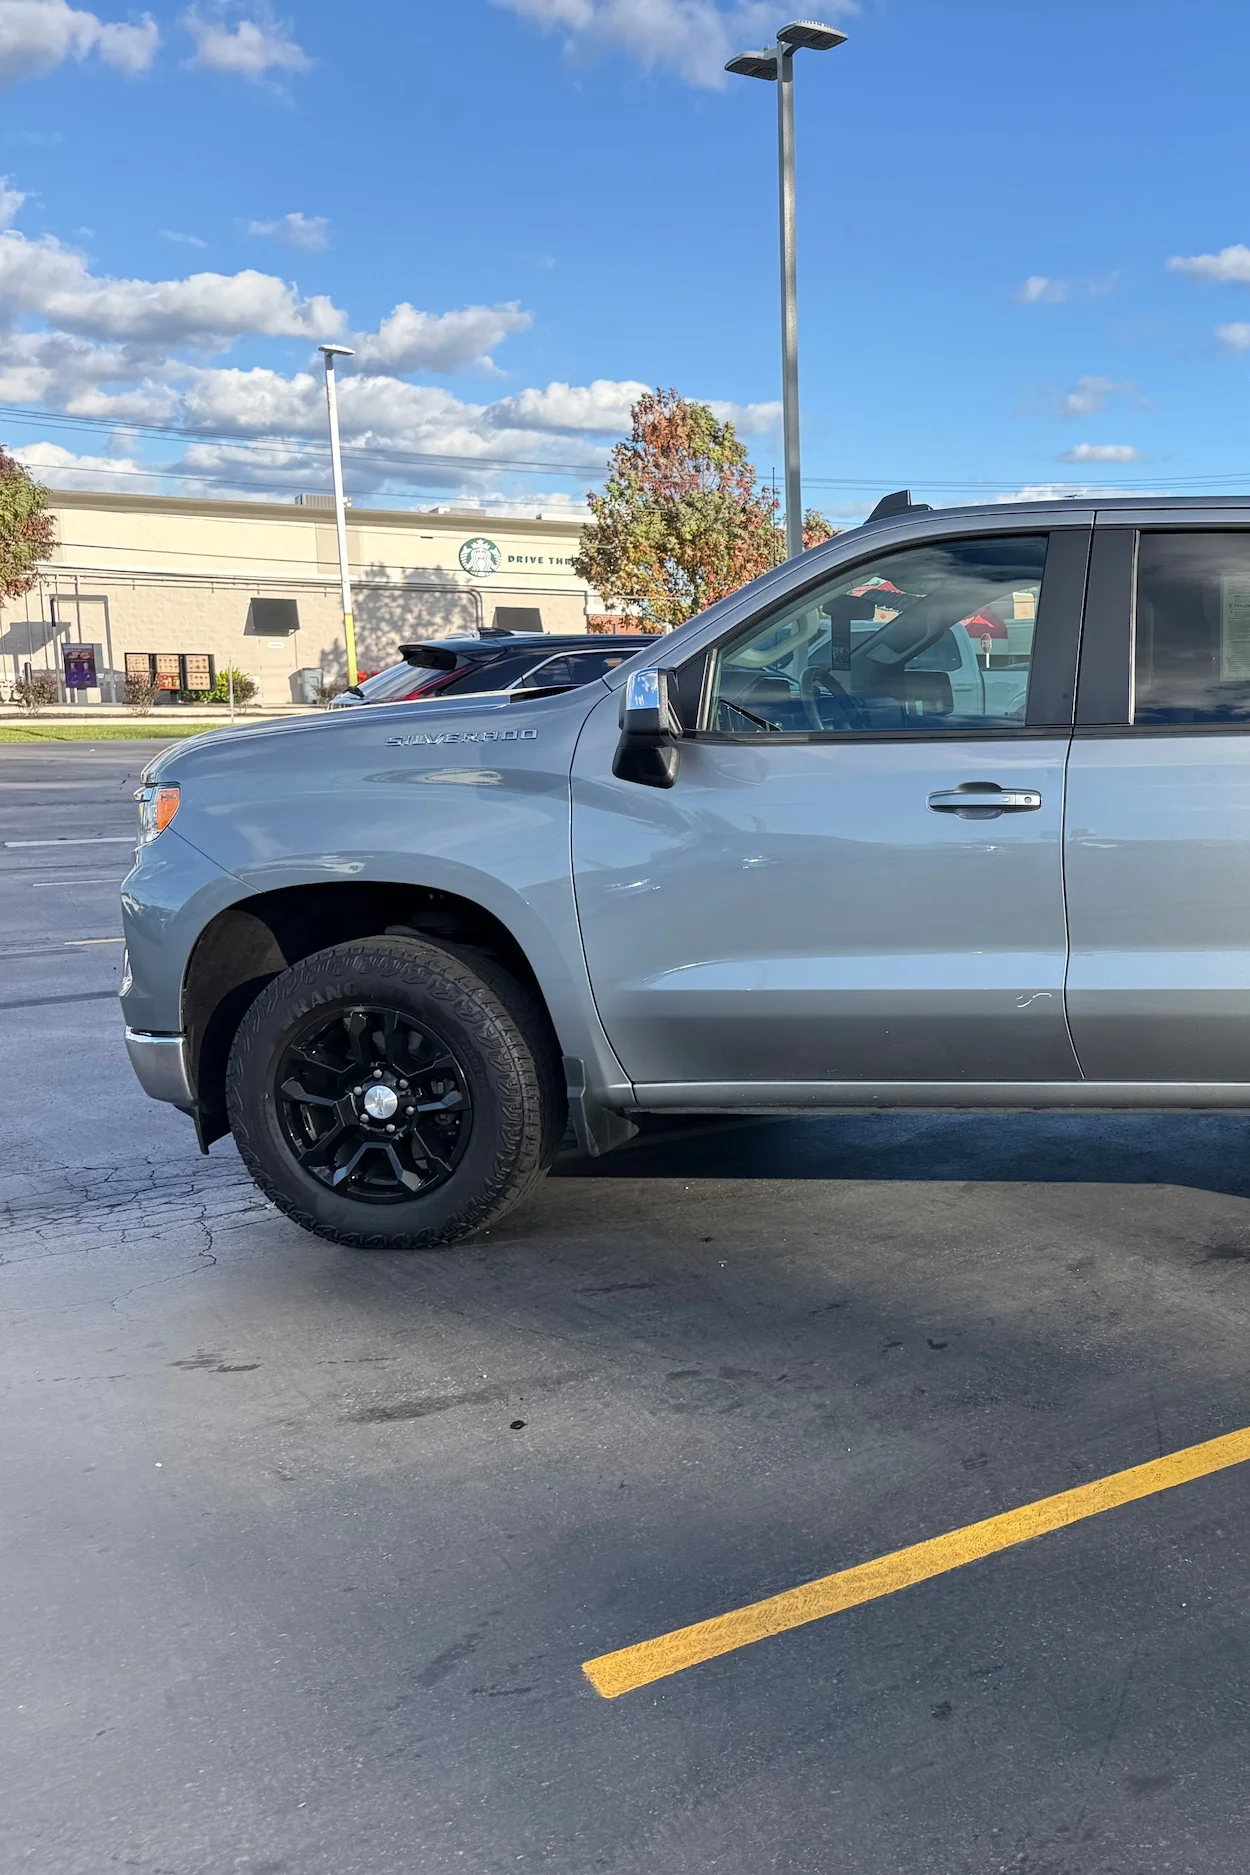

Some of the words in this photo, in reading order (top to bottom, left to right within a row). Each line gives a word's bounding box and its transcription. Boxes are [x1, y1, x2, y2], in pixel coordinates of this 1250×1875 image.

[507, 555, 544, 565] DRIVE
[548, 557, 573, 566] THR
[384, 729, 539, 747] SILVERADO
